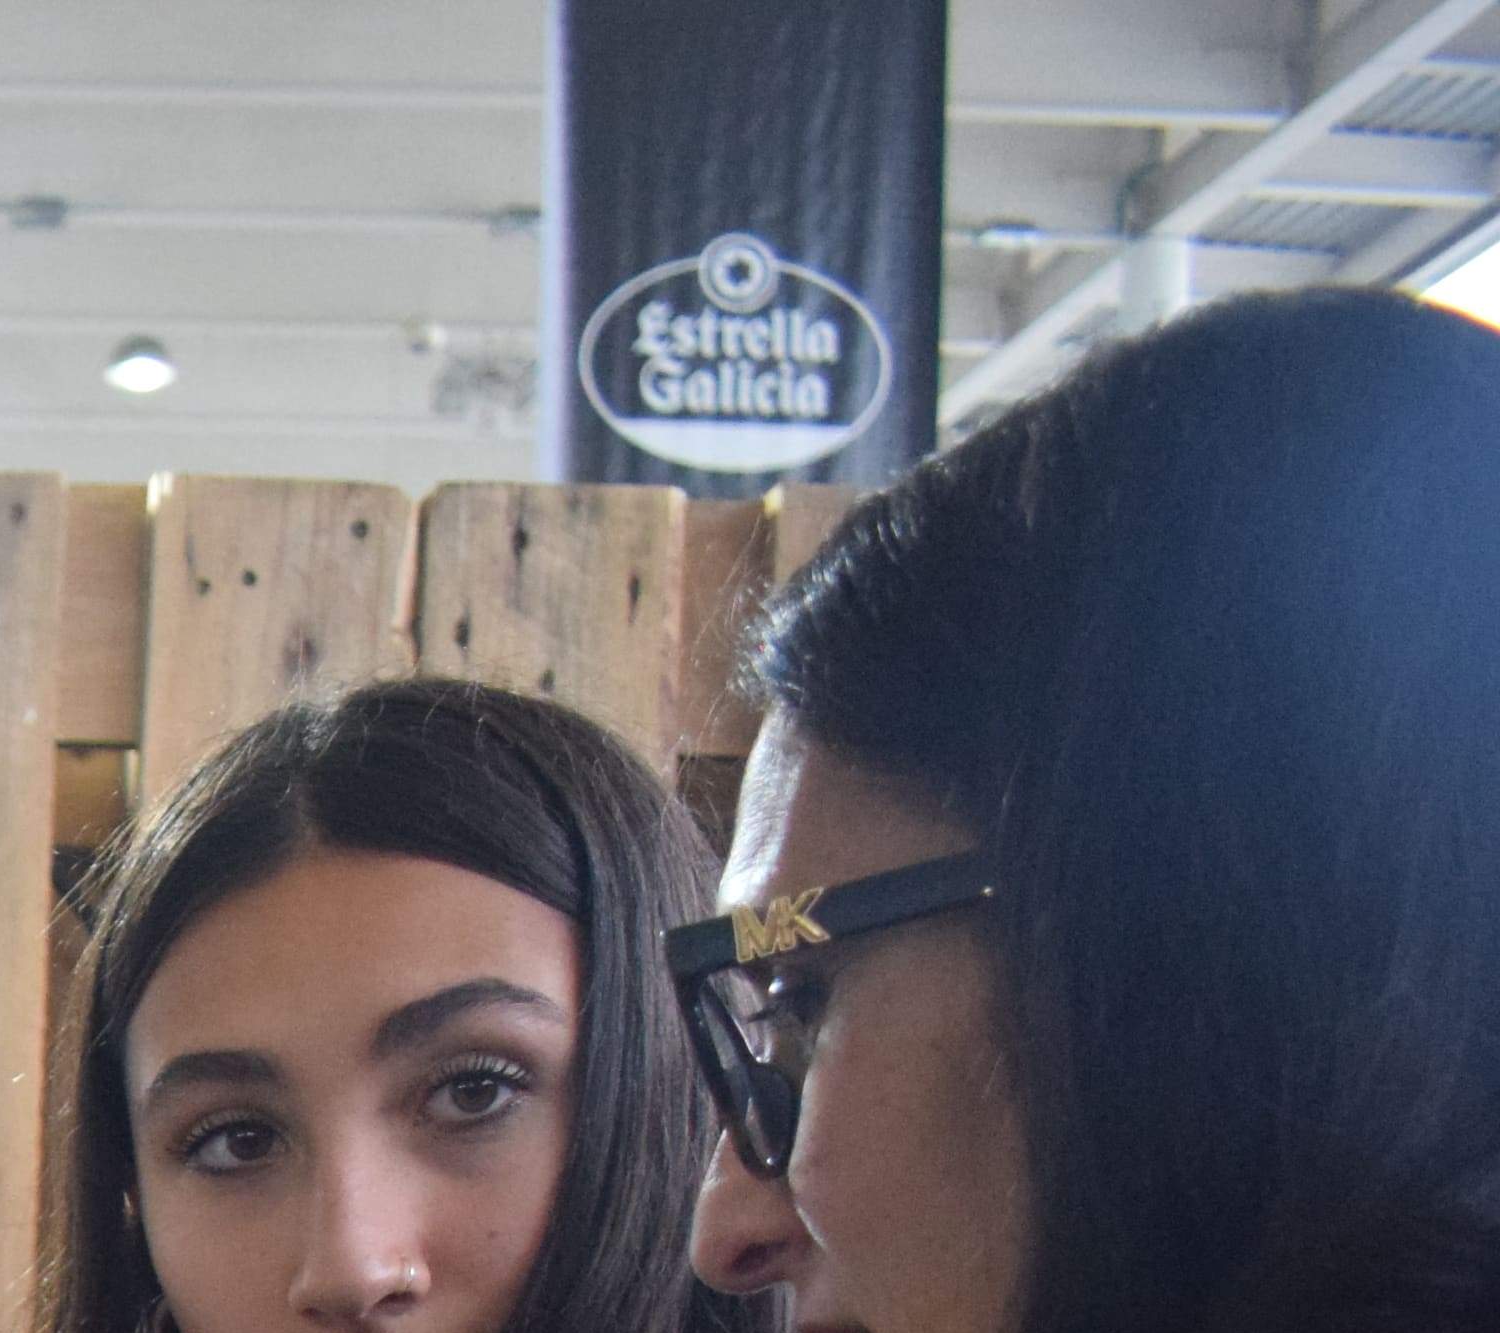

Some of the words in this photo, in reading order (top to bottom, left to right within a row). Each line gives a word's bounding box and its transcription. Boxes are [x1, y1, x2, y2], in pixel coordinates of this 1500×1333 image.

[631, 301, 840, 365] Estrella
[638, 356, 831, 417] Galicia
[731, 887, 831, 963] MK
